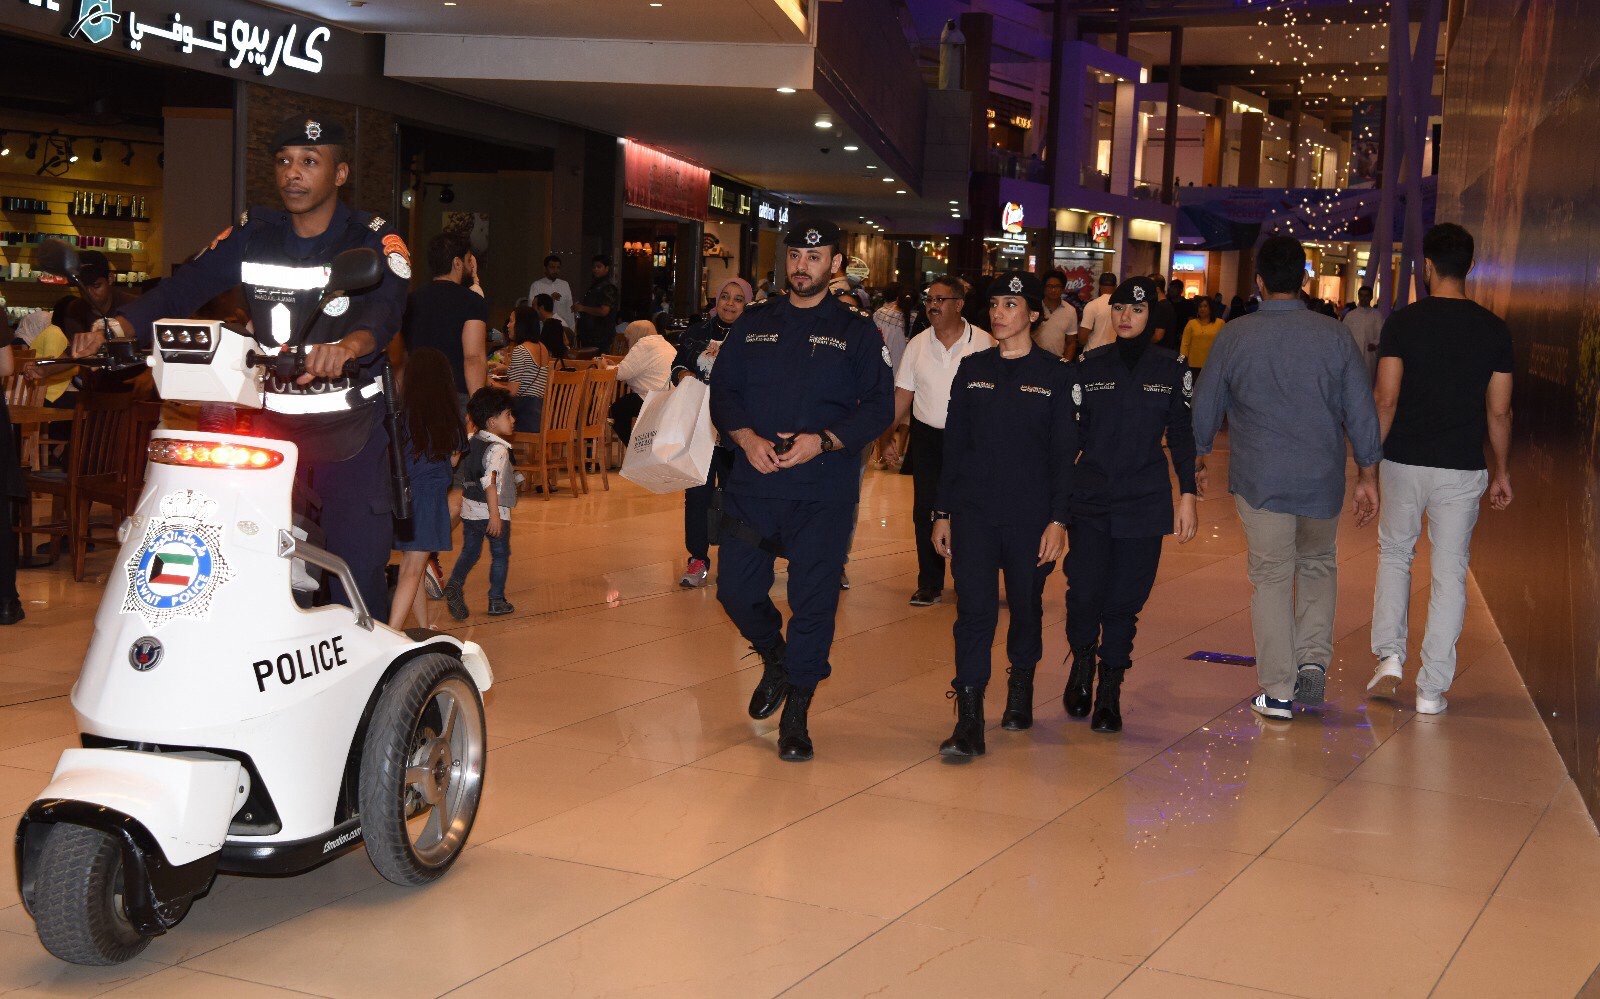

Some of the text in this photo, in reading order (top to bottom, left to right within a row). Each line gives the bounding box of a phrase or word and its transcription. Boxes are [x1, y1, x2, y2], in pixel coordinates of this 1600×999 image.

[129, 11, 331, 77] كاريبو كوفي
[1065, 277, 1087, 290] ne's
[136, 569, 210, 606] KUWAIT POLICE
[253, 635, 348, 692] POLICE
